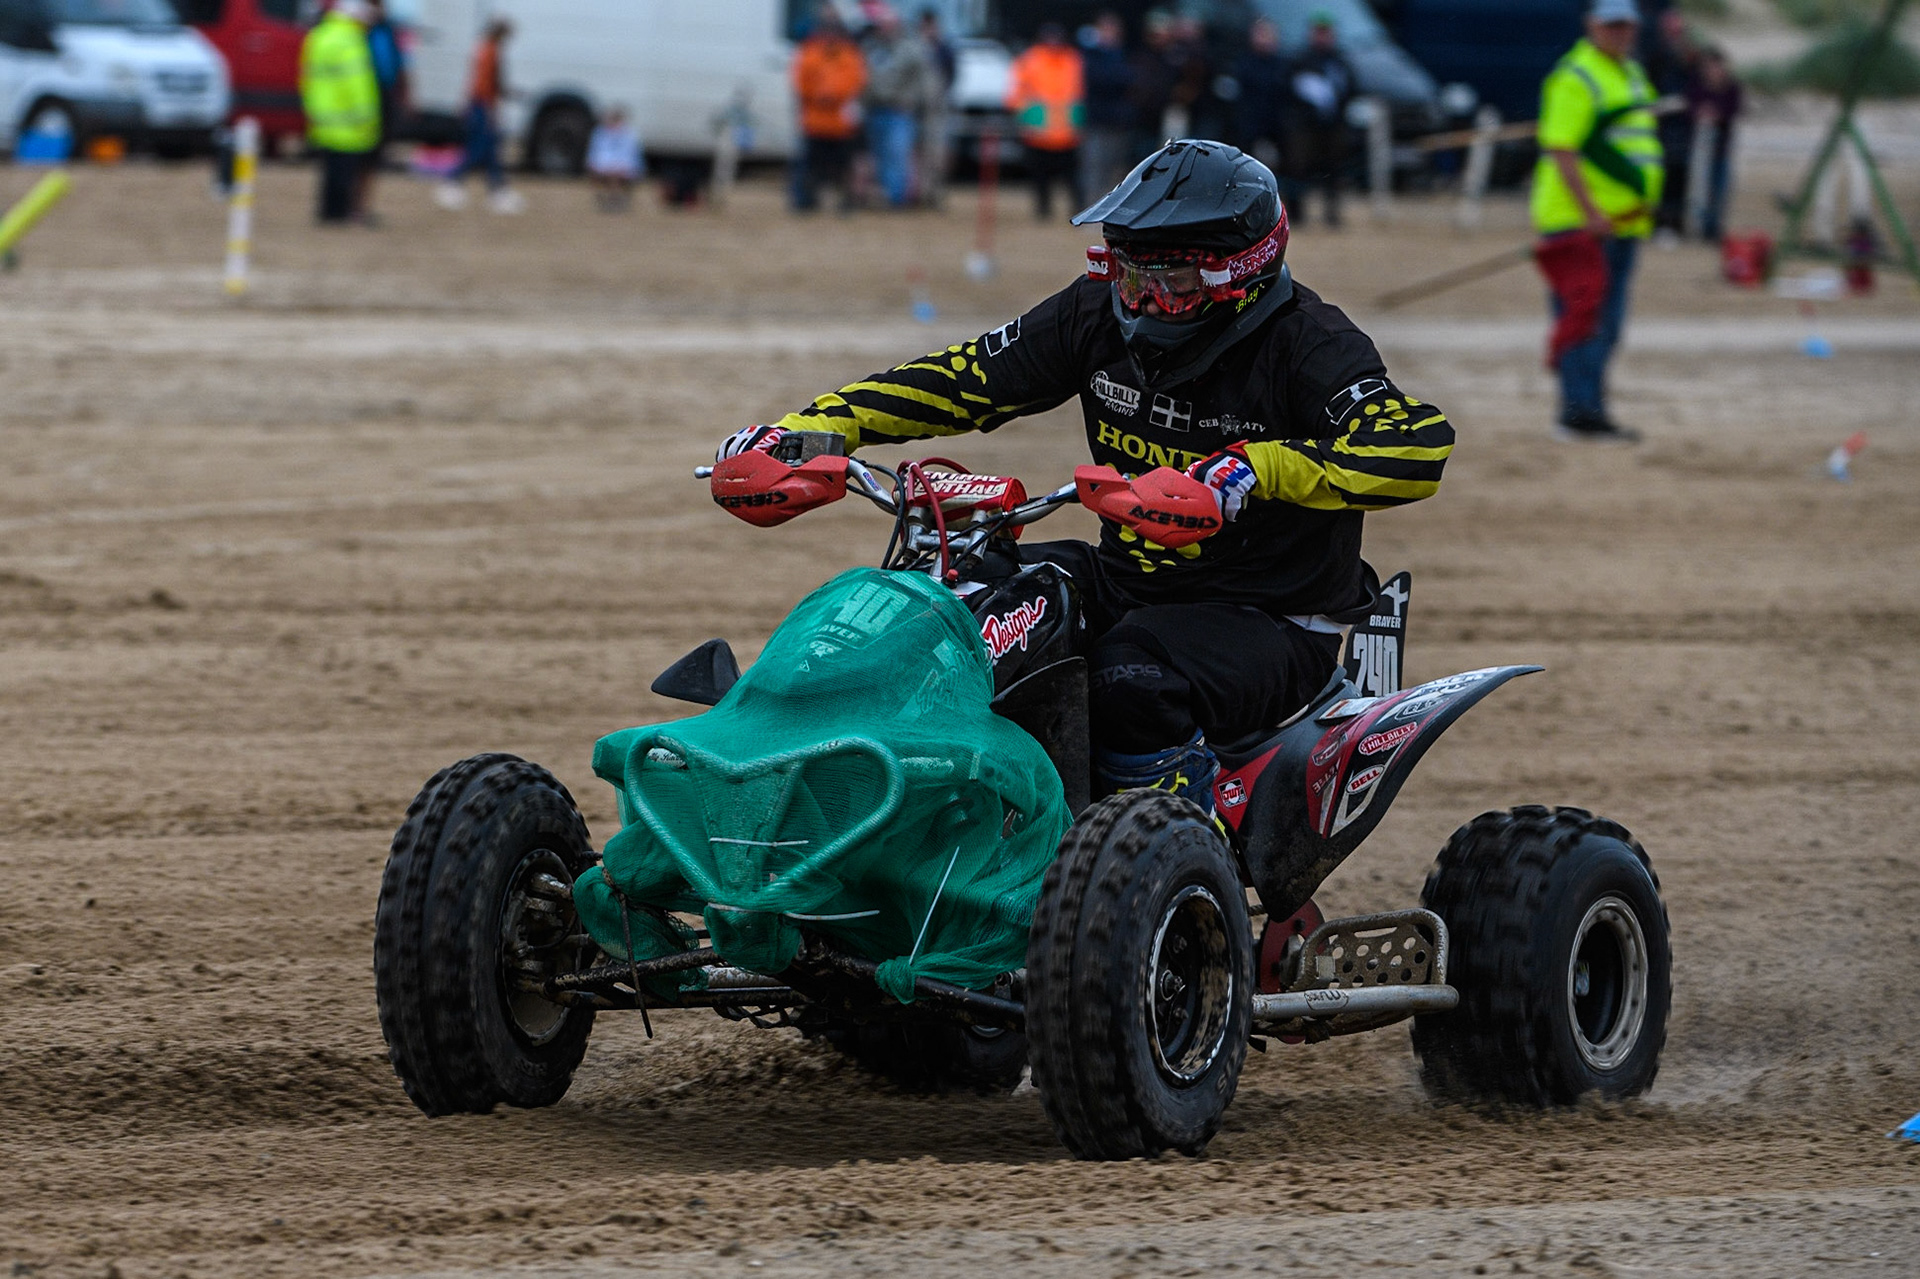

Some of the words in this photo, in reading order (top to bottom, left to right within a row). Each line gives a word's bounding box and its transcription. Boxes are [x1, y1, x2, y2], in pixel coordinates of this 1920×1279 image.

[1198, 417, 1220, 428] CEB
[1241, 421, 1267, 433] ATV
[981, 596, 1047, 658] Designs
[1368, 725, 1413, 751] HILLBILLY
[1351, 769, 1380, 791] BELL
